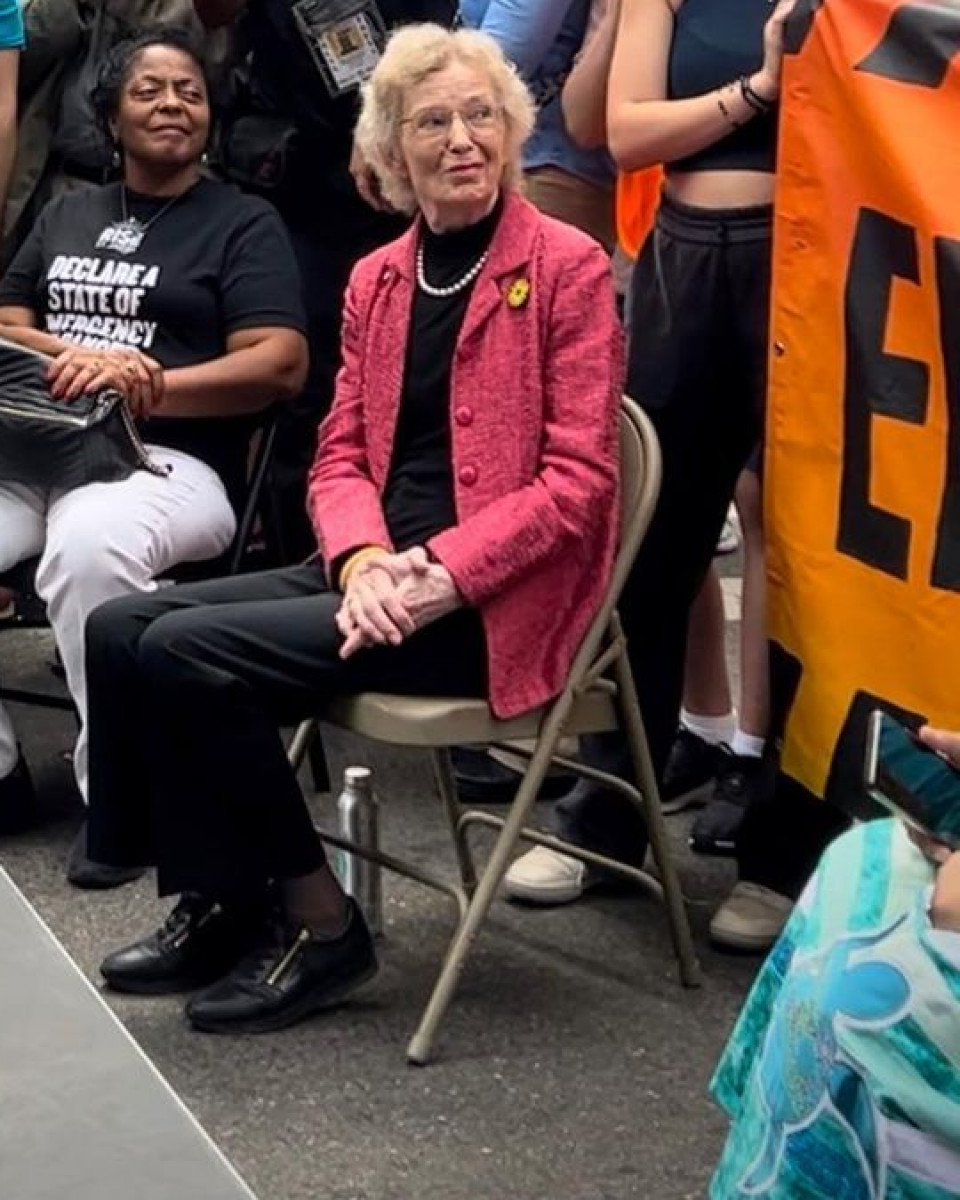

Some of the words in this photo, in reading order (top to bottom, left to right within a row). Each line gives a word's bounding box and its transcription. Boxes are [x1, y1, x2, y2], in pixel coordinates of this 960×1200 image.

[48, 256, 146, 286] DECLARE
[141, 265, 161, 288] A
[48, 281, 113, 314] STATE
[114, 288, 146, 316] OF
